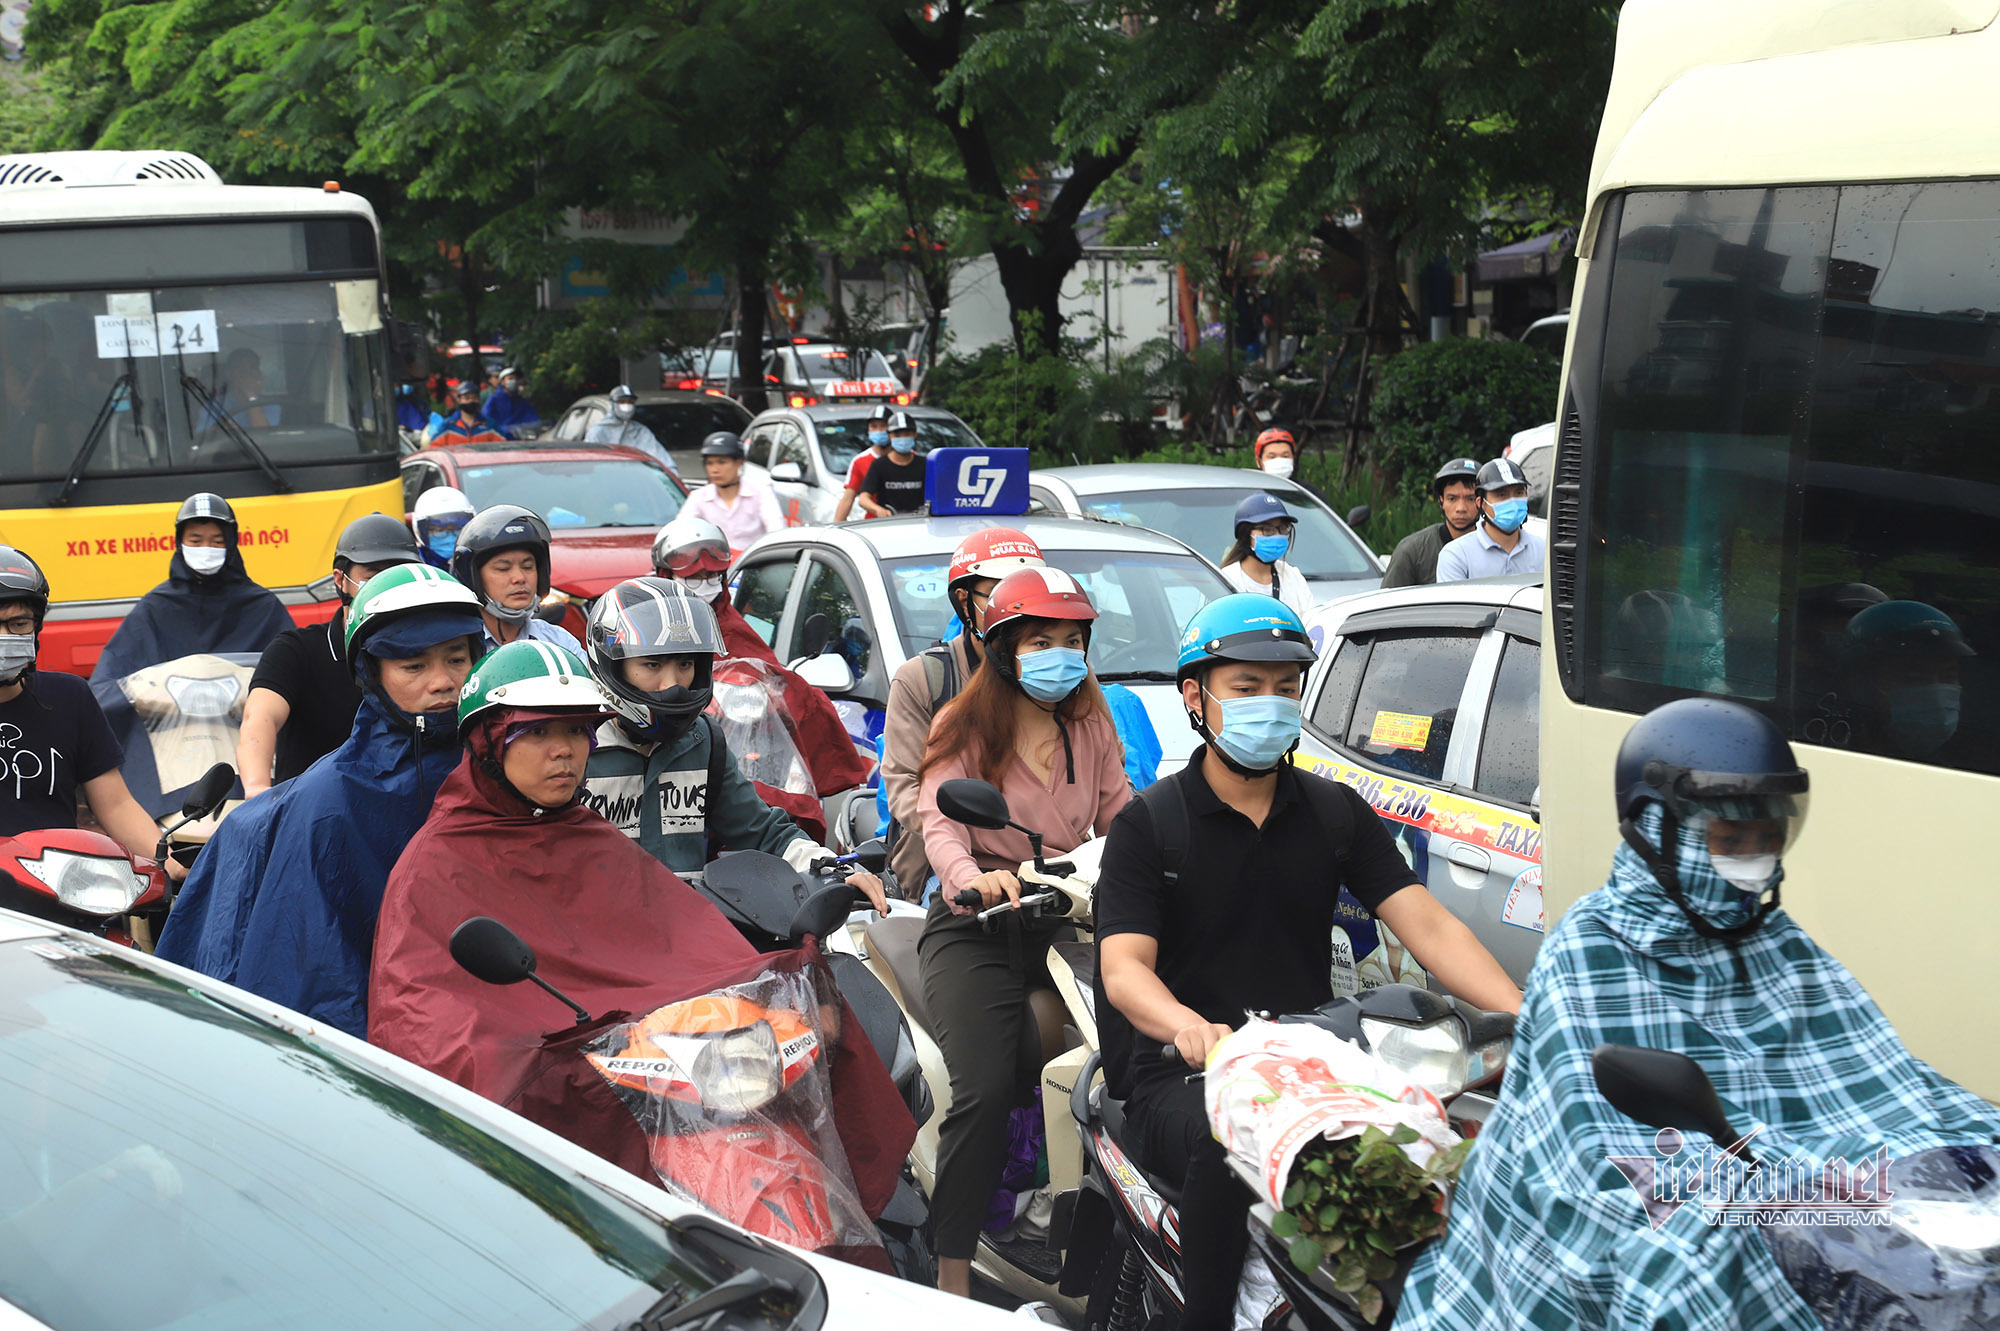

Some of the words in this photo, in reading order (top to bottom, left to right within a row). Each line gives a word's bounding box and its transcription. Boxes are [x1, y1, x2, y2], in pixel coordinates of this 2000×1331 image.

[171, 323, 204, 349] 24
[957, 456, 1008, 508] G7
[954, 498, 981, 508] TAXI
[95, 538, 117, 555] XE
[258, 525, 289, 549] NỘI
[1496, 821, 1542, 857] TAXI
[1356, 906, 1370, 920] Cao
[607, 1059, 676, 1073] REPSOL
